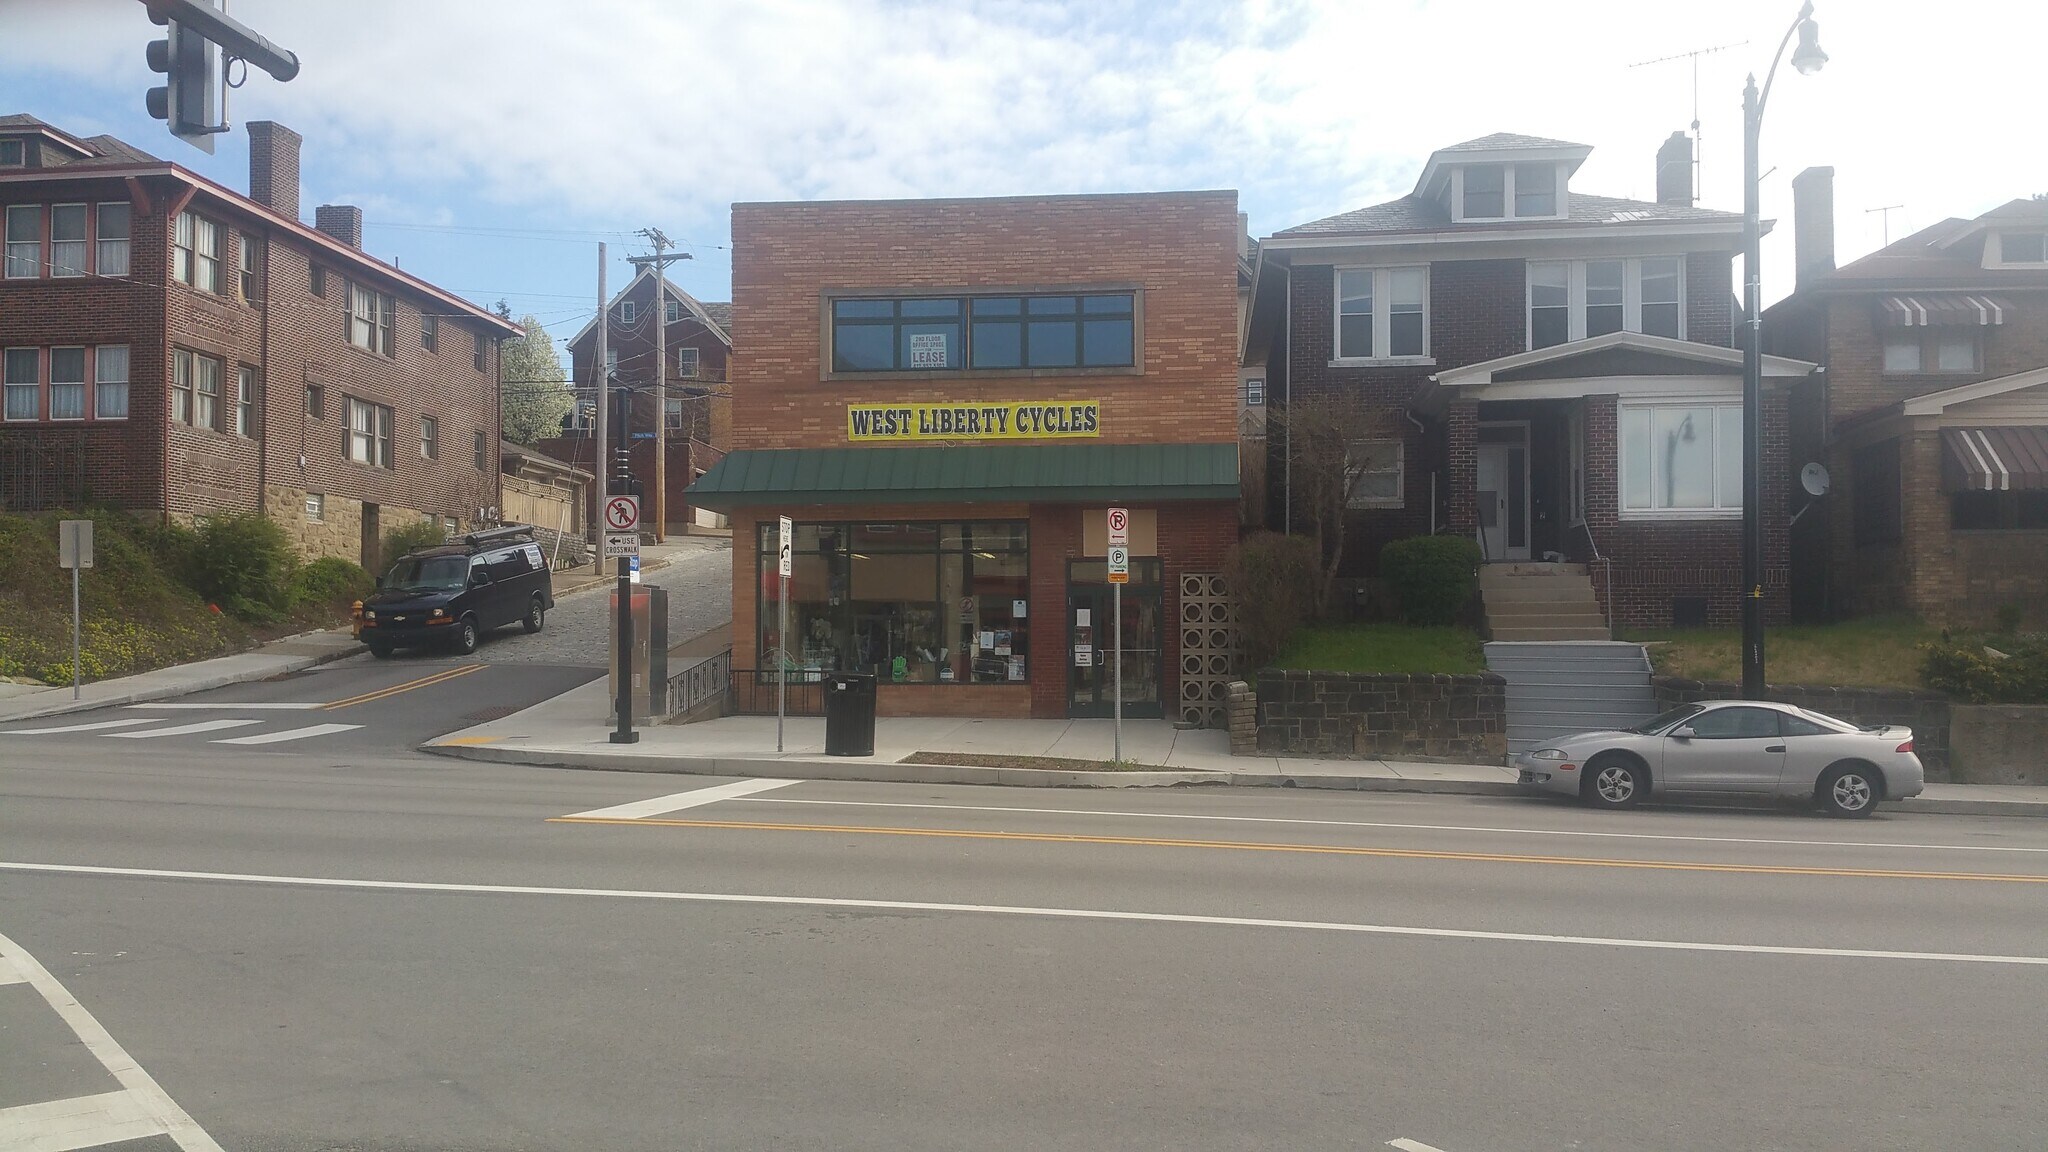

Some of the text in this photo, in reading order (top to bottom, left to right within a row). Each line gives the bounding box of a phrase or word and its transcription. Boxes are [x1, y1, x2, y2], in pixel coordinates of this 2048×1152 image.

[912, 351, 945, 363] LEASE
[850, 405, 1098, 436] WEST LIBERTY CYCLES
[781, 521, 791, 534] STOP
[621, 537, 635, 545] USE
[606, 546, 638, 554] CROSSWALK
